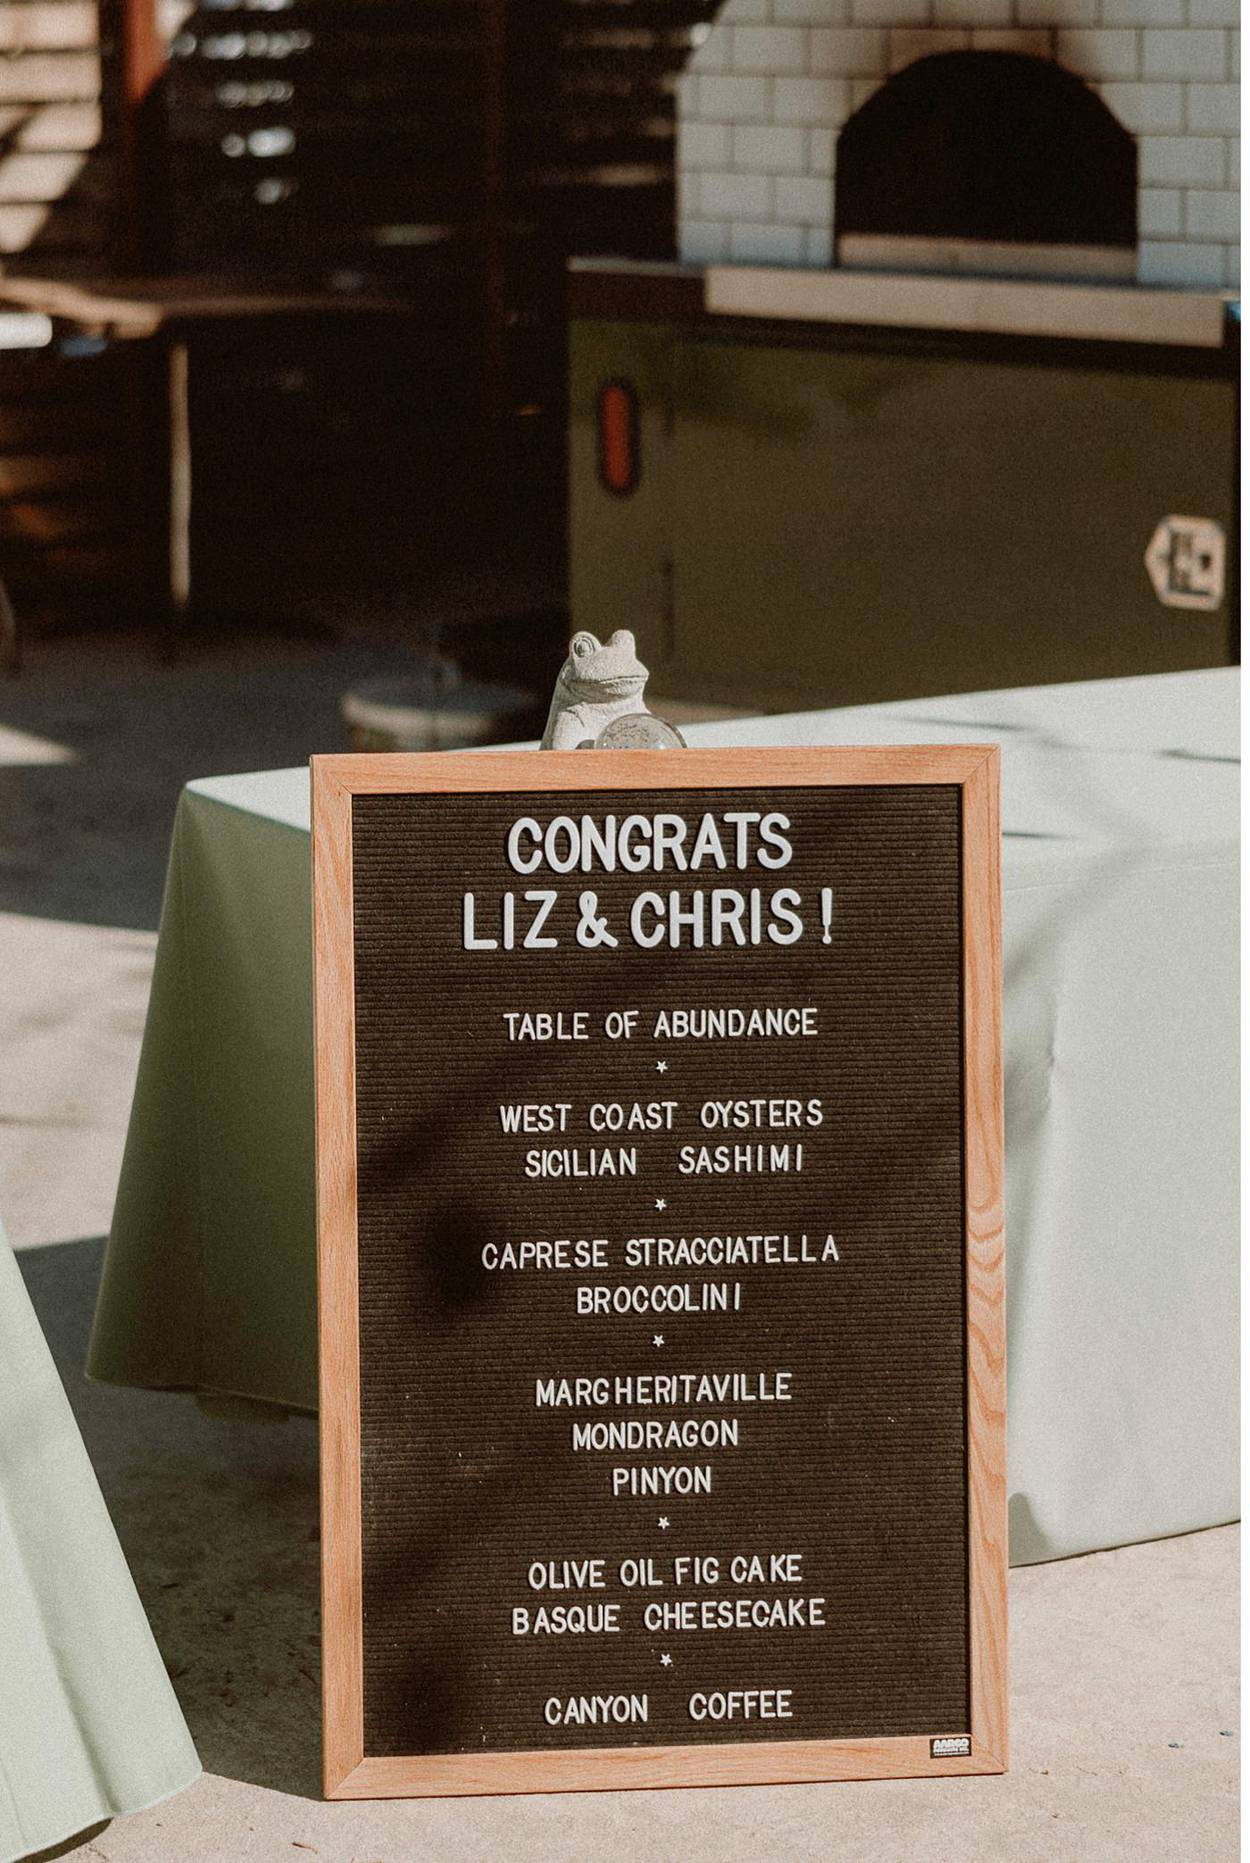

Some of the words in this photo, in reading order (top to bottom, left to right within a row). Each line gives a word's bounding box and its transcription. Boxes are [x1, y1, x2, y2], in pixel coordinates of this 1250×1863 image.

[508, 812, 793, 874] CONGRATS
[463, 890, 558, 950] LIZ
[576, 890, 619, 948] &
[502, 1011, 590, 1041] TABLE
[605, 1010, 639, 1039] OF
[653, 1007, 818, 1039] ABUNDANCE
[499, 1103, 573, 1133] WEST
[589, 1101, 679, 1132] COAST
[700, 1098, 824, 1129] OYSTERS
[524, 1147, 637, 1178] SICILIAN
[678, 1143, 803, 1174] SASHIMI
[481, 1239, 609, 1270] CAPRESE
[625, 1234, 840, 1267] STRACCIATELLA
[577, 1282, 741, 1314] BROCCOLINI
[536, 1372, 793, 1407] MARGHERITAVILLE
[573, 1418, 738, 1451] MONDRAGON
[613, 1465, 712, 1497] PINYON
[528, 1559, 606, 1591] OLIVE
[620, 1558, 664, 1587] OIL
[674, 1556, 720, 1586] FIG
[730, 1554, 803, 1584] CAKE
[512, 1603, 621, 1635] BASQUE
[644, 1597, 826, 1631] CHEESECAKE
[544, 1694, 648, 1726] CANYON
[689, 1689, 793, 1721] COFFEE
